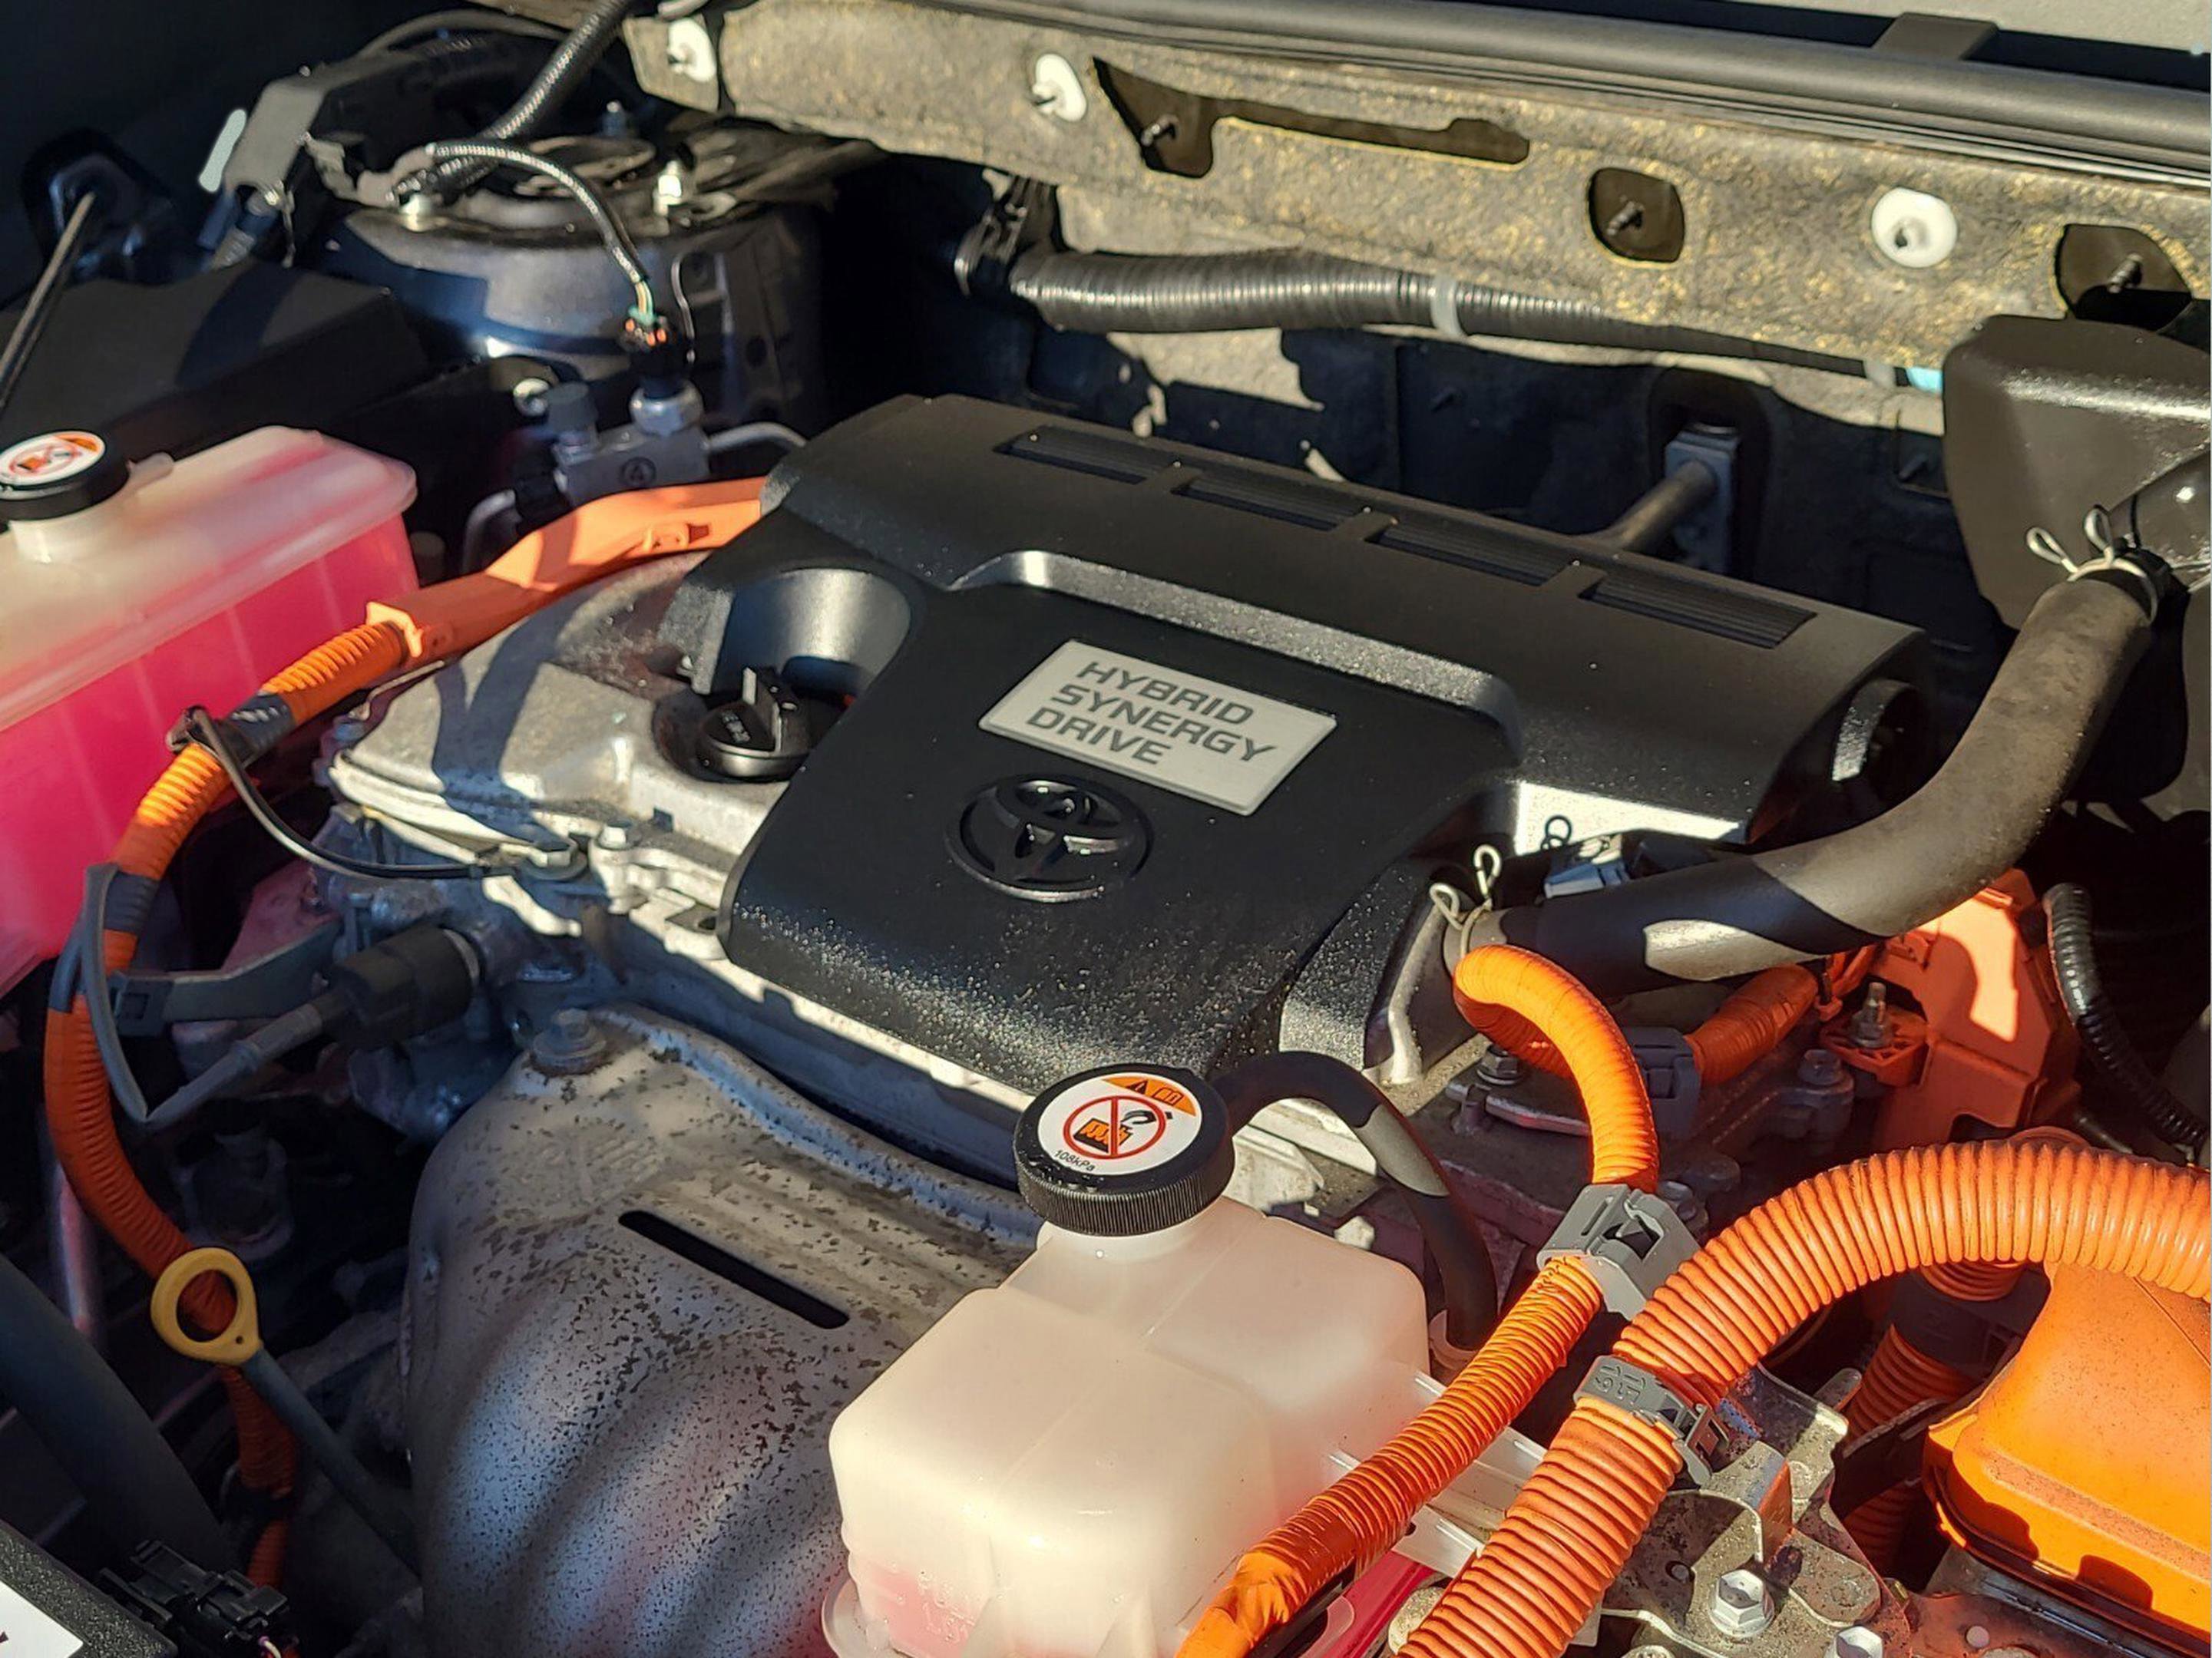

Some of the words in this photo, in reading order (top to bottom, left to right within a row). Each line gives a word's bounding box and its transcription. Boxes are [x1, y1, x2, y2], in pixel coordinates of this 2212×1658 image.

[1050, 684, 1277, 761] SYNERGY
[1076, 661, 1254, 726] HYBRID
[1027, 707, 1172, 765] DRIVE
[1053, 1150, 1096, 1171] 108kPa
